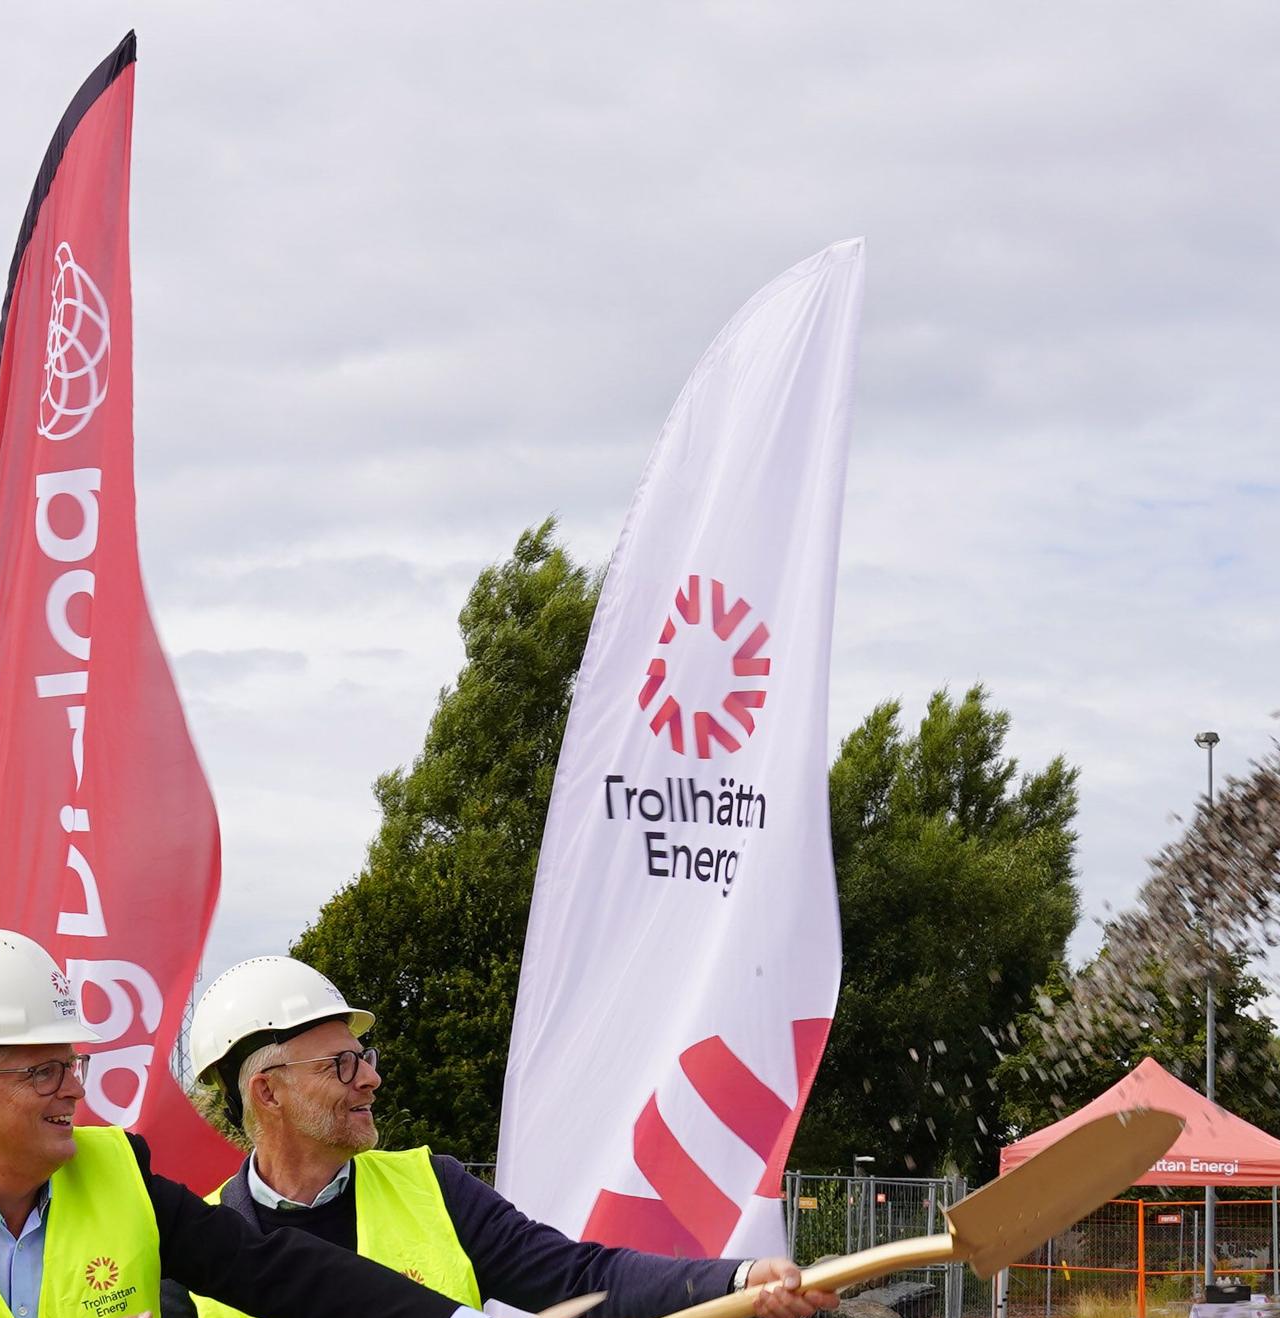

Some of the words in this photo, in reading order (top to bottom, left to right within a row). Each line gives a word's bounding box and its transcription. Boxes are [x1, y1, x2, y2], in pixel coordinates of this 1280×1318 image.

[1190, 1158, 1239, 1176] Energi
[82, 1286, 137, 1310] Trollhättan
[96, 1298, 128, 1318] Energi
